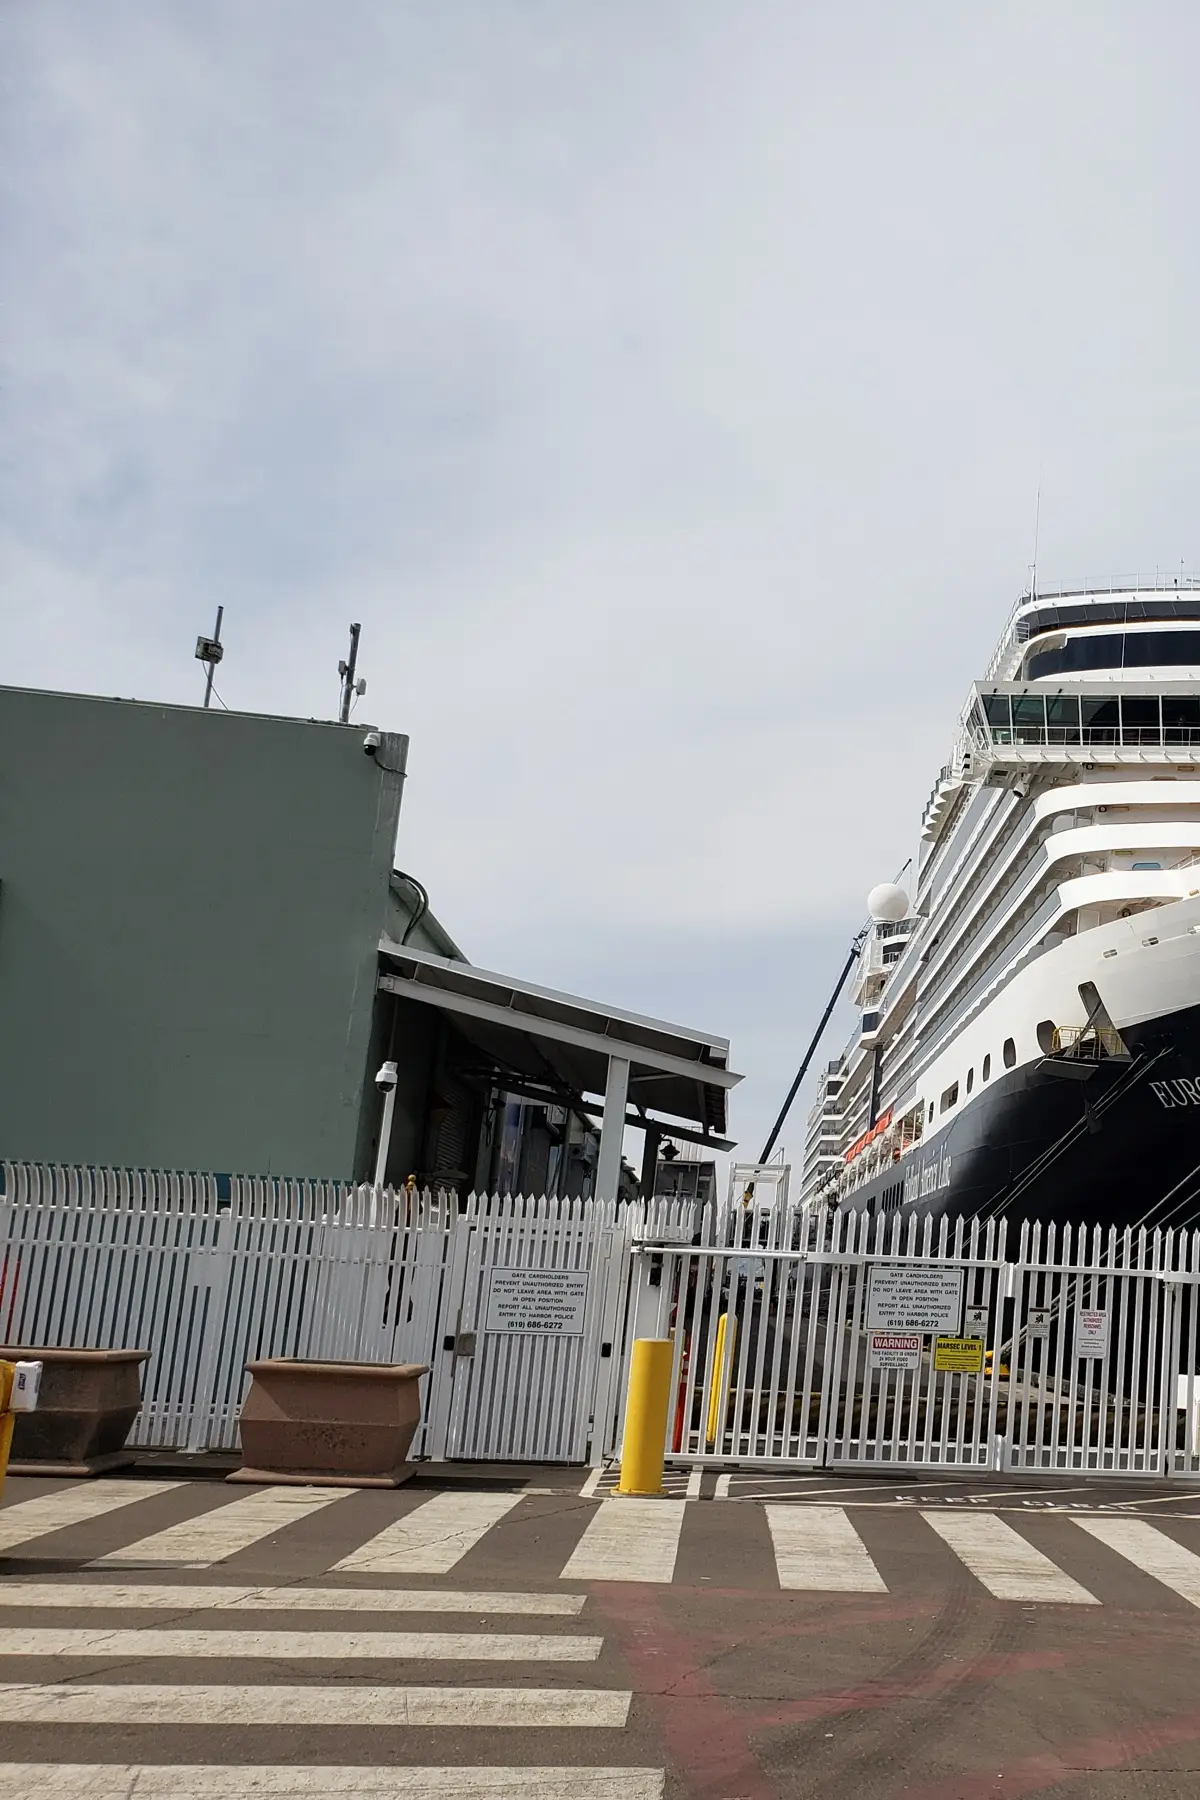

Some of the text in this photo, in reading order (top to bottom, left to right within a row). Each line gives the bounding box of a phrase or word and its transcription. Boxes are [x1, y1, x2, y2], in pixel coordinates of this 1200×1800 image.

[938, 1141, 952, 1189] Line
[507, 1321, 563, 1329] (619) 686-6272
[874, 1338, 917, 1348] WARNING
[895, 1495, 989, 1504] KEEP
